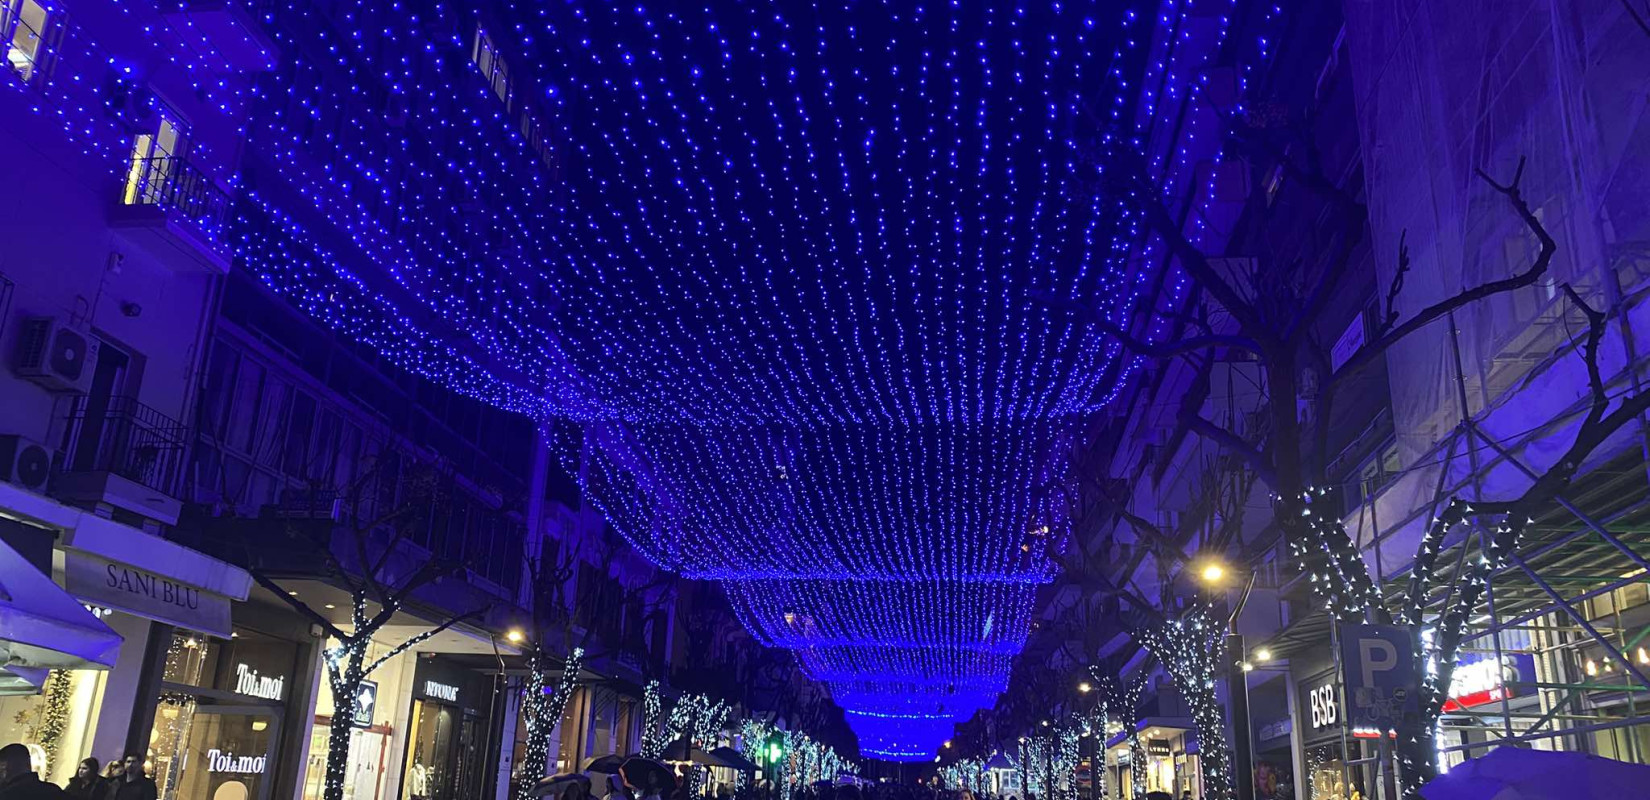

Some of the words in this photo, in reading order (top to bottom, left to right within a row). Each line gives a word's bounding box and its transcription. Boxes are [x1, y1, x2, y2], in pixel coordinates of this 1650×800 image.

[106, 564, 156, 599] SANI
[162, 579, 199, 610] BLU
[235, 663, 284, 700] Toi&moi
[1358, 638, 1398, 690] P
[1310, 683, 1336, 728] BSB
[207, 748, 267, 773] Toi&moi
